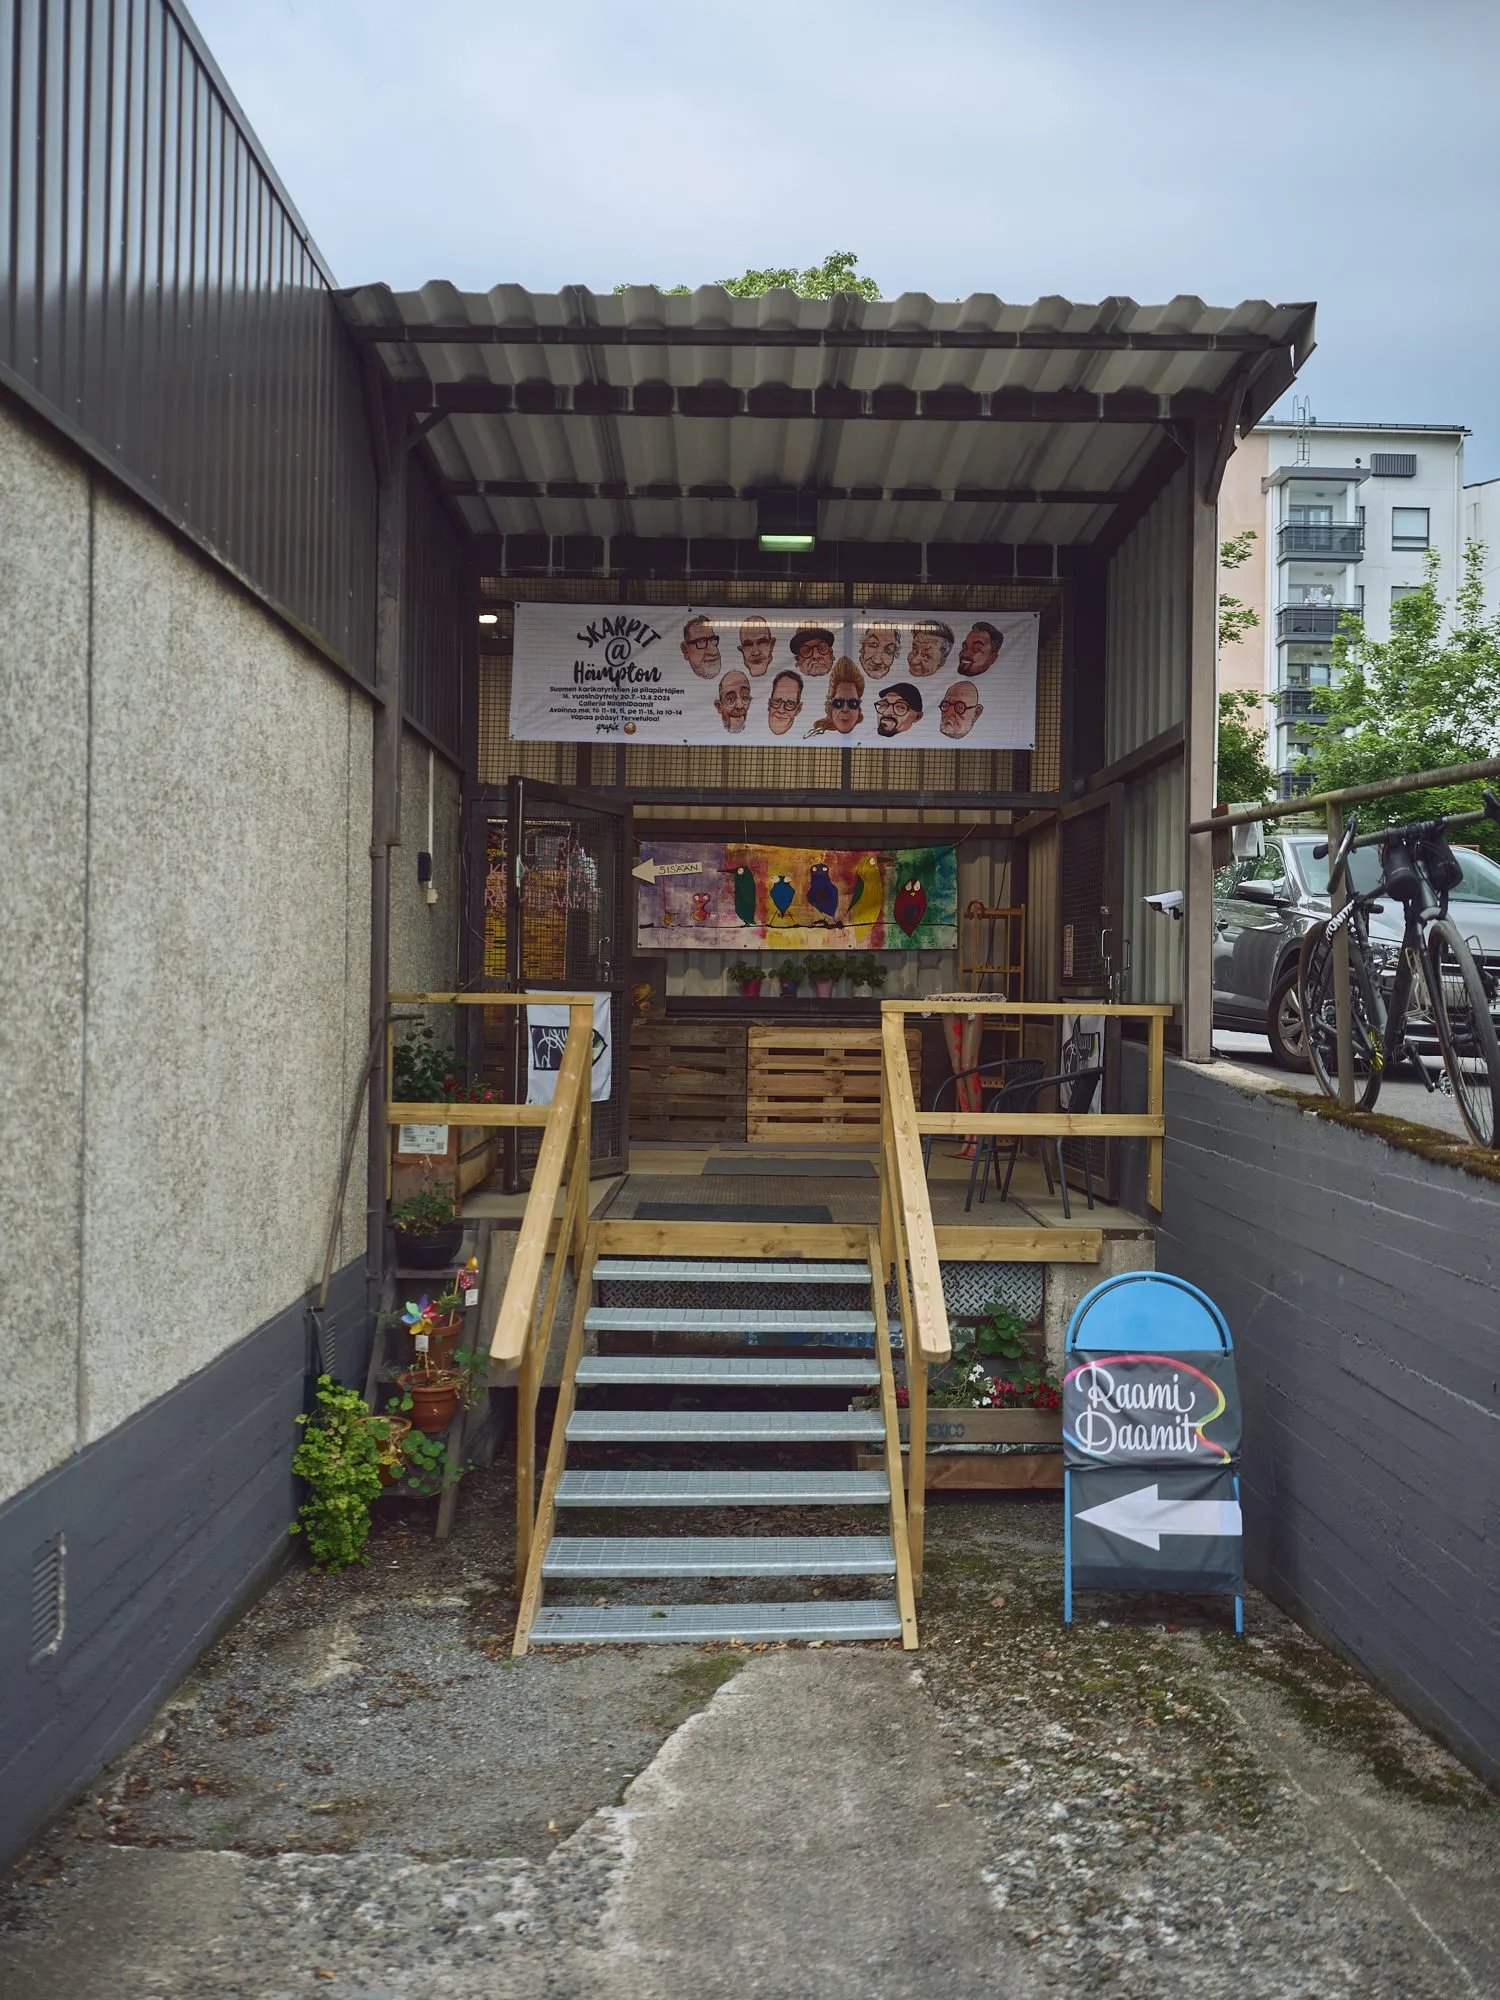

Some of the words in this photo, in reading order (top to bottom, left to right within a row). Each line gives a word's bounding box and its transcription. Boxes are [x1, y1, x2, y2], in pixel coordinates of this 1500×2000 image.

[576, 615, 662, 648] SKARPIT
[604, 637, 632, 667] @
[573, 660, 662, 688] Hämpton
[572, 693, 619, 701] vuosinäyttely
[578, 686, 630, 694] karikatyristien
[640, 687, 685, 695] pilapiirtäjien
[594, 714, 619, 722] pääsy!
[658, 864, 699, 875] SISÄÄN
[1074, 1361, 1196, 1414] Raami
[1074, 1404, 1206, 1455] Daamit
